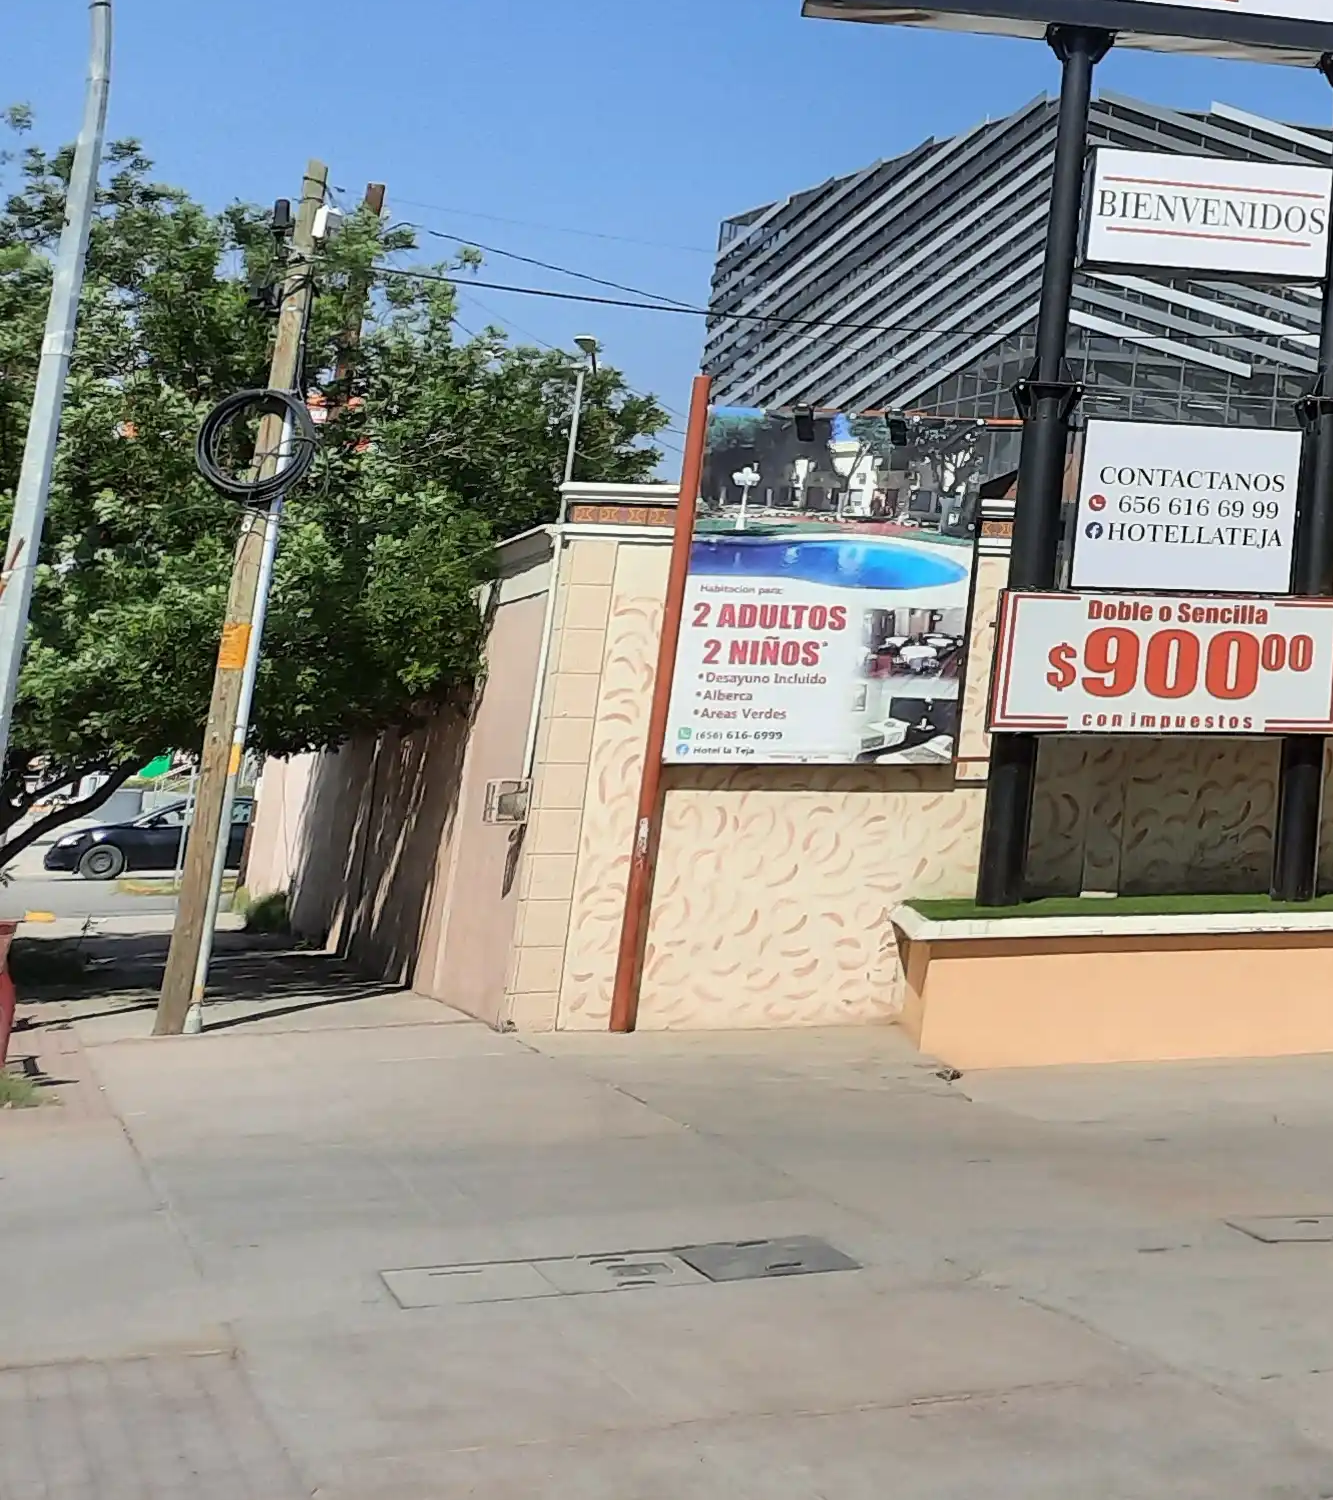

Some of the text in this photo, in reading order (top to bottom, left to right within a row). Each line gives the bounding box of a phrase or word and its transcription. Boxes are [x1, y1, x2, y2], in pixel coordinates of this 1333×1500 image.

[1097, 189, 1325, 234] BIENVENIDOS
[1099, 466, 1285, 493] CONTACTANOS
[1118, 495, 1279, 519] 656 616 69 99
[1107, 522, 1282, 549] HOTELLATEJA
[692, 602, 847, 631] 2 ADULTOS
[1087, 600, 1268, 625] Doble o Sencilla
[702, 638, 722, 665] 2
[705, 672, 827, 686] Desayuno Incluido
[703, 690, 753, 701] Alberca
[742, 708, 787, 720] Verdes
[1082, 712, 1253, 730] con impuestos
